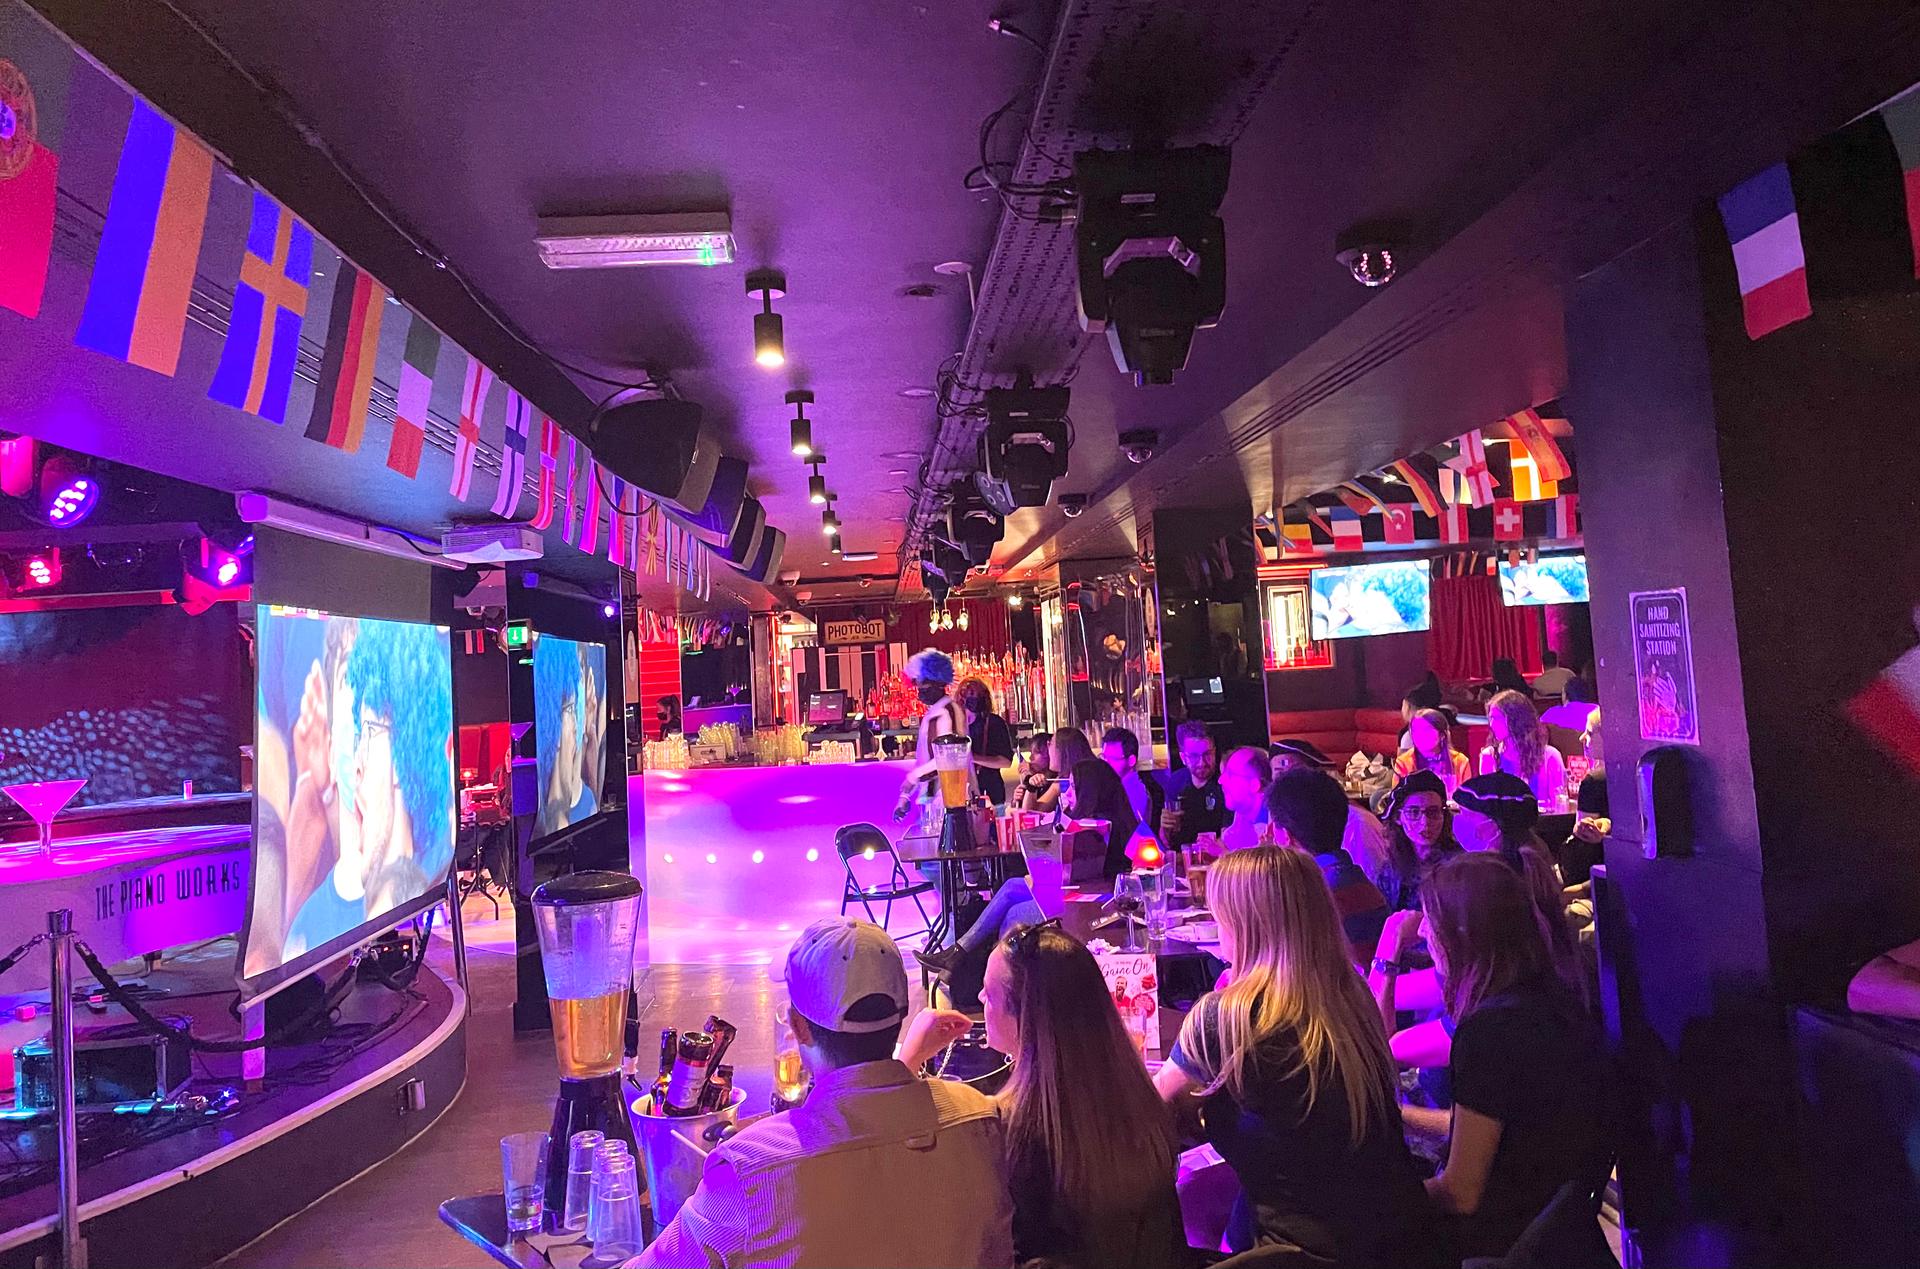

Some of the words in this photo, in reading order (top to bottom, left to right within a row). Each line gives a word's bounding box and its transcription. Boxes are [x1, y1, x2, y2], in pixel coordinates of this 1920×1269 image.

[1648, 606, 1669, 621] HAND
[828, 623, 881, 640] PHOTOBOT
[1639, 622, 1681, 638] SANITIZING
[1646, 640, 1677, 656] STATION
[95, 883, 114, 921] THE
[120, 873, 165, 914] PIANO
[176, 861, 240, 900] WORKS
